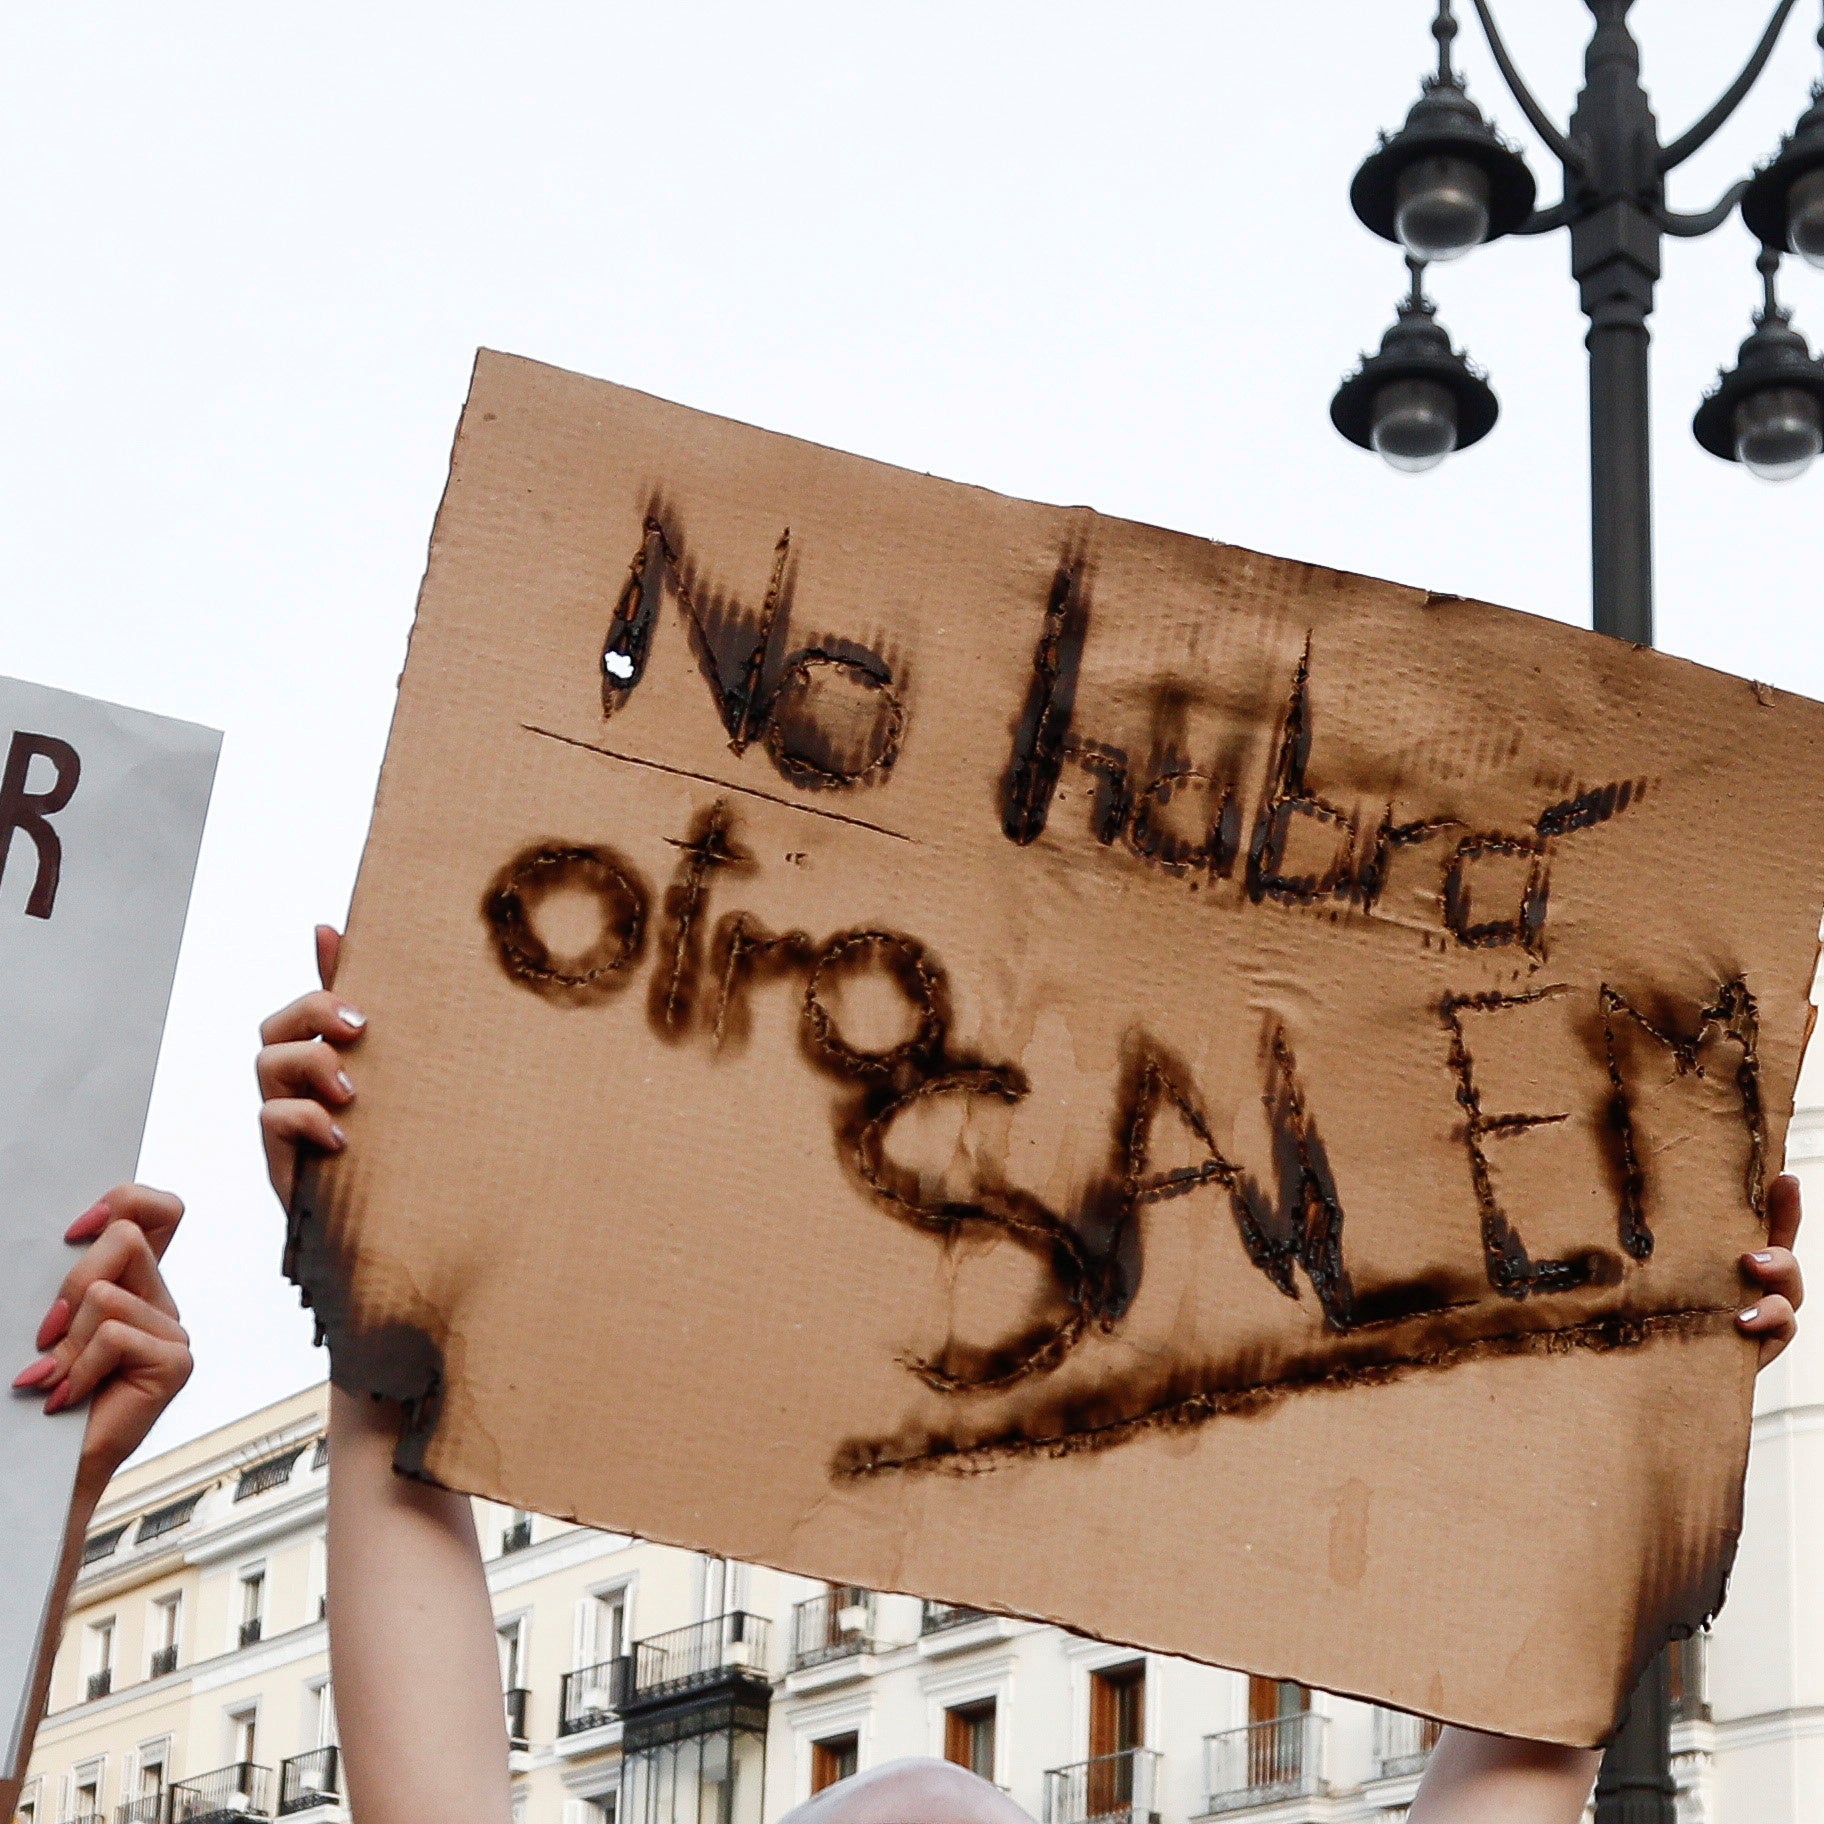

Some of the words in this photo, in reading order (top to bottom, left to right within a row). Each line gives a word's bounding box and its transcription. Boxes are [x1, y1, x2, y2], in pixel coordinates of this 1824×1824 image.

[600, 508, 909, 791] No
[480, 797, 950, 1085] otro
[837, 970, 1768, 1396] SALEM
